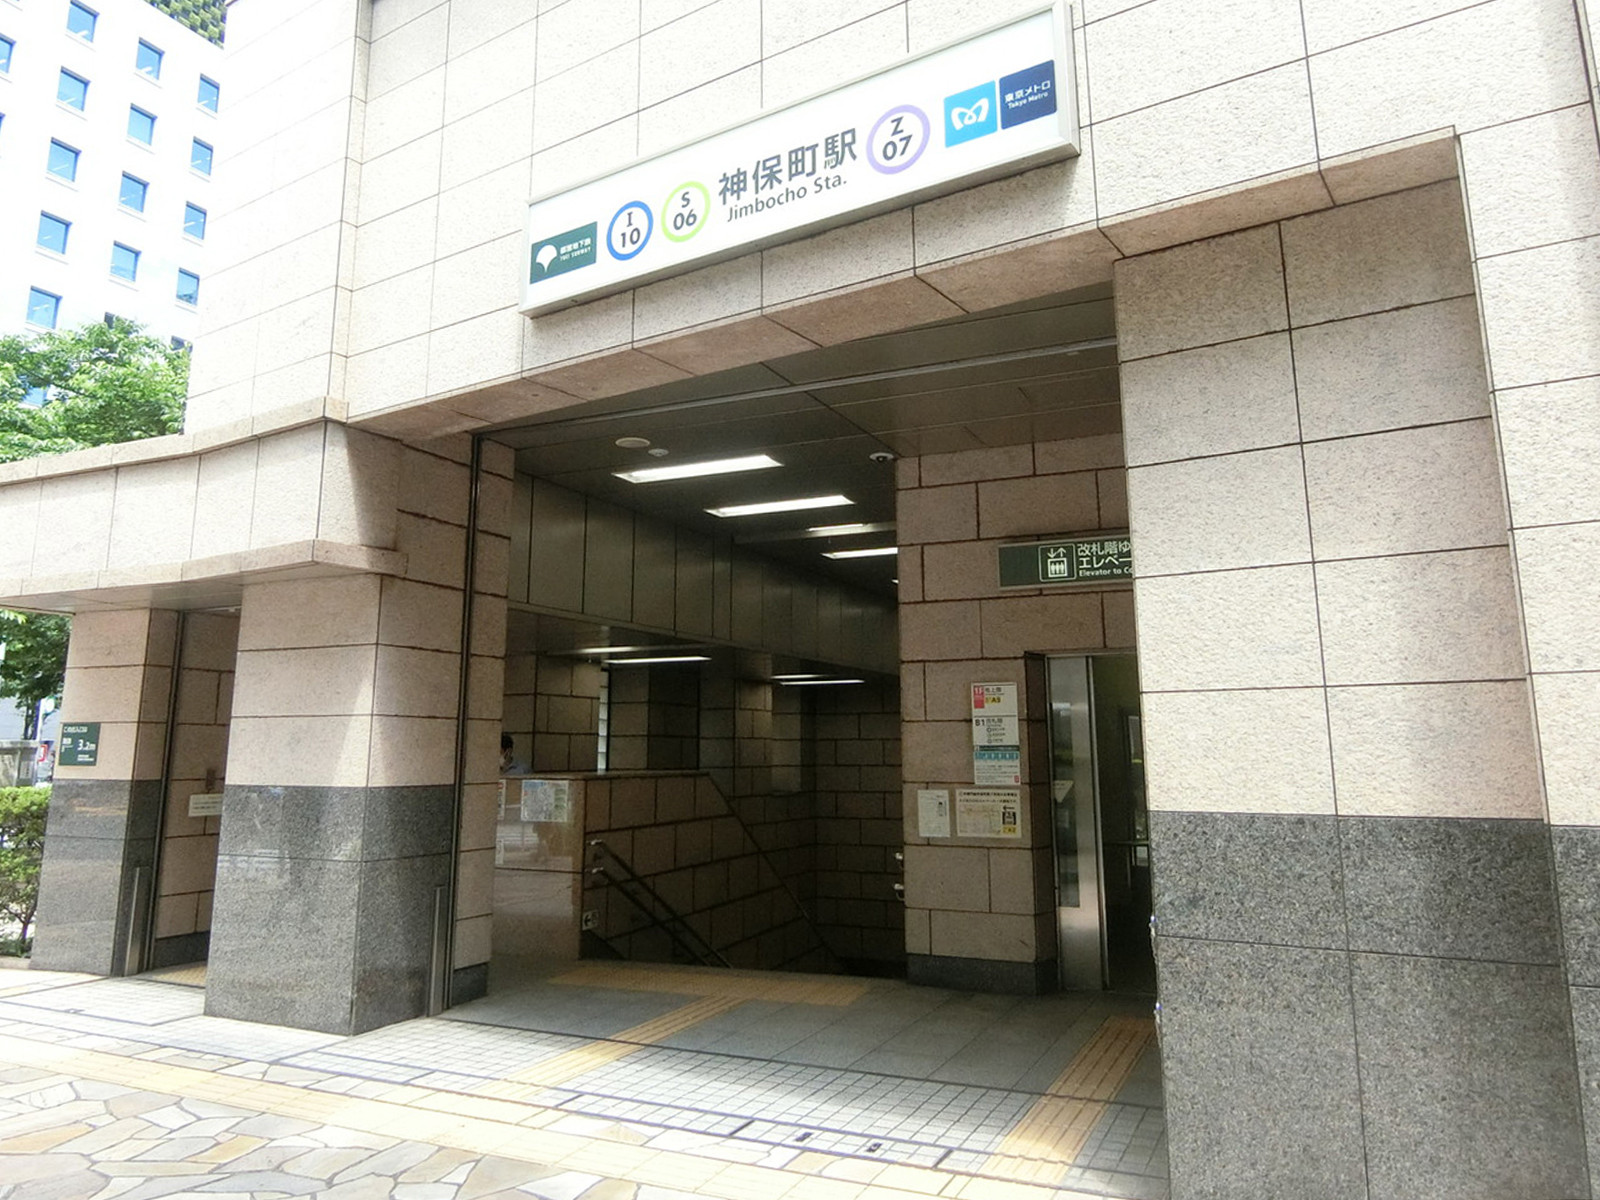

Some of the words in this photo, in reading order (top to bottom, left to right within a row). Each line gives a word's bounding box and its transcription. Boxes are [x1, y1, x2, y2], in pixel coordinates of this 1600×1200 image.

[1004, 80, 1051, 103] 東京メトロ
[1008, 99, 1027, 109] Tokyo
[1028, 91, 1049, 102] Metro
[891, 115, 904, 137] Z
[882, 133, 913, 162] 07
[718, 127, 857, 206] 神保町駅
[681, 191, 691, 209] S
[727, 186, 808, 222] Jimbocho
[813, 174, 847, 194] Sta.
[626, 211, 634, 228] I
[673, 208, 697, 231] 06
[620, 227, 641, 248] 10
[1079, 568, 1111, 577] Elevator
[77, 739, 96, 751] 3.2m
